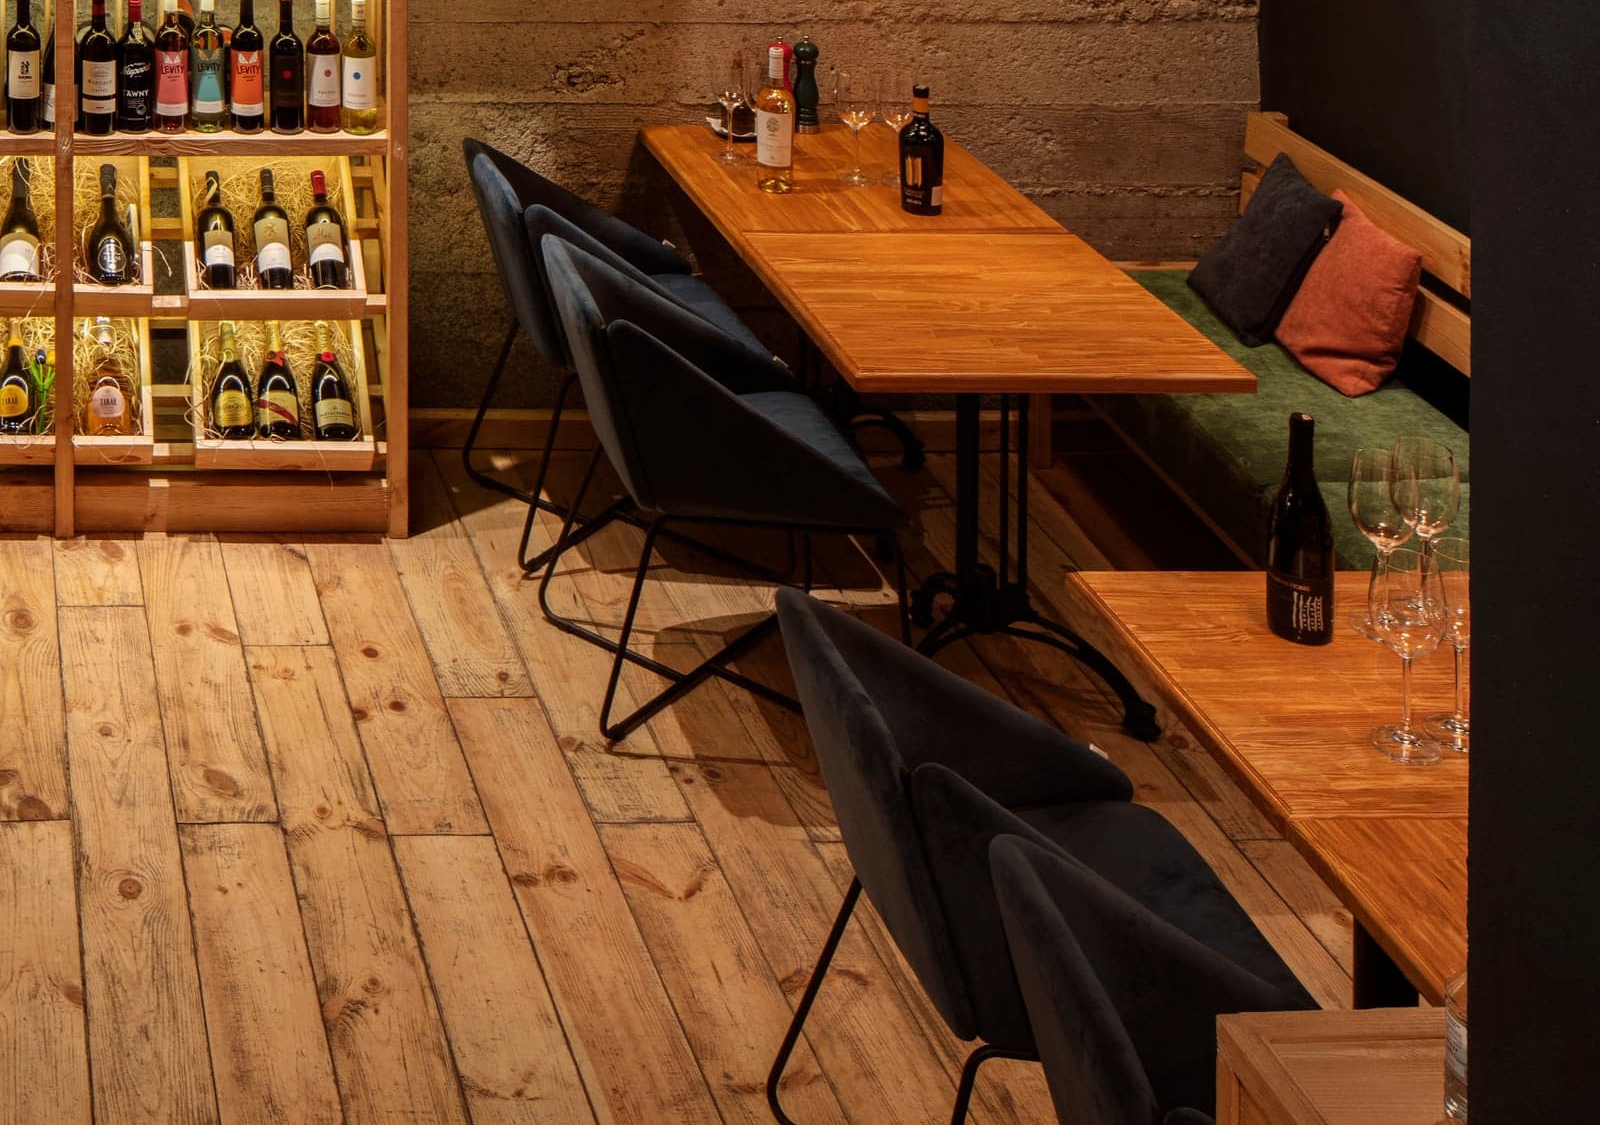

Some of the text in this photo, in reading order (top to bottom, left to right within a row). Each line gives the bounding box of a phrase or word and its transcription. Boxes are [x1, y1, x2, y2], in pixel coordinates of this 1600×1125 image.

[160, 63, 184, 75] LEVITY
[197, 63, 220, 74] LEVITY
[235, 63, 259, 75] LEVITY
[122, 89, 149, 97] TAWNY
[100, 397, 117, 406] TAKAR
